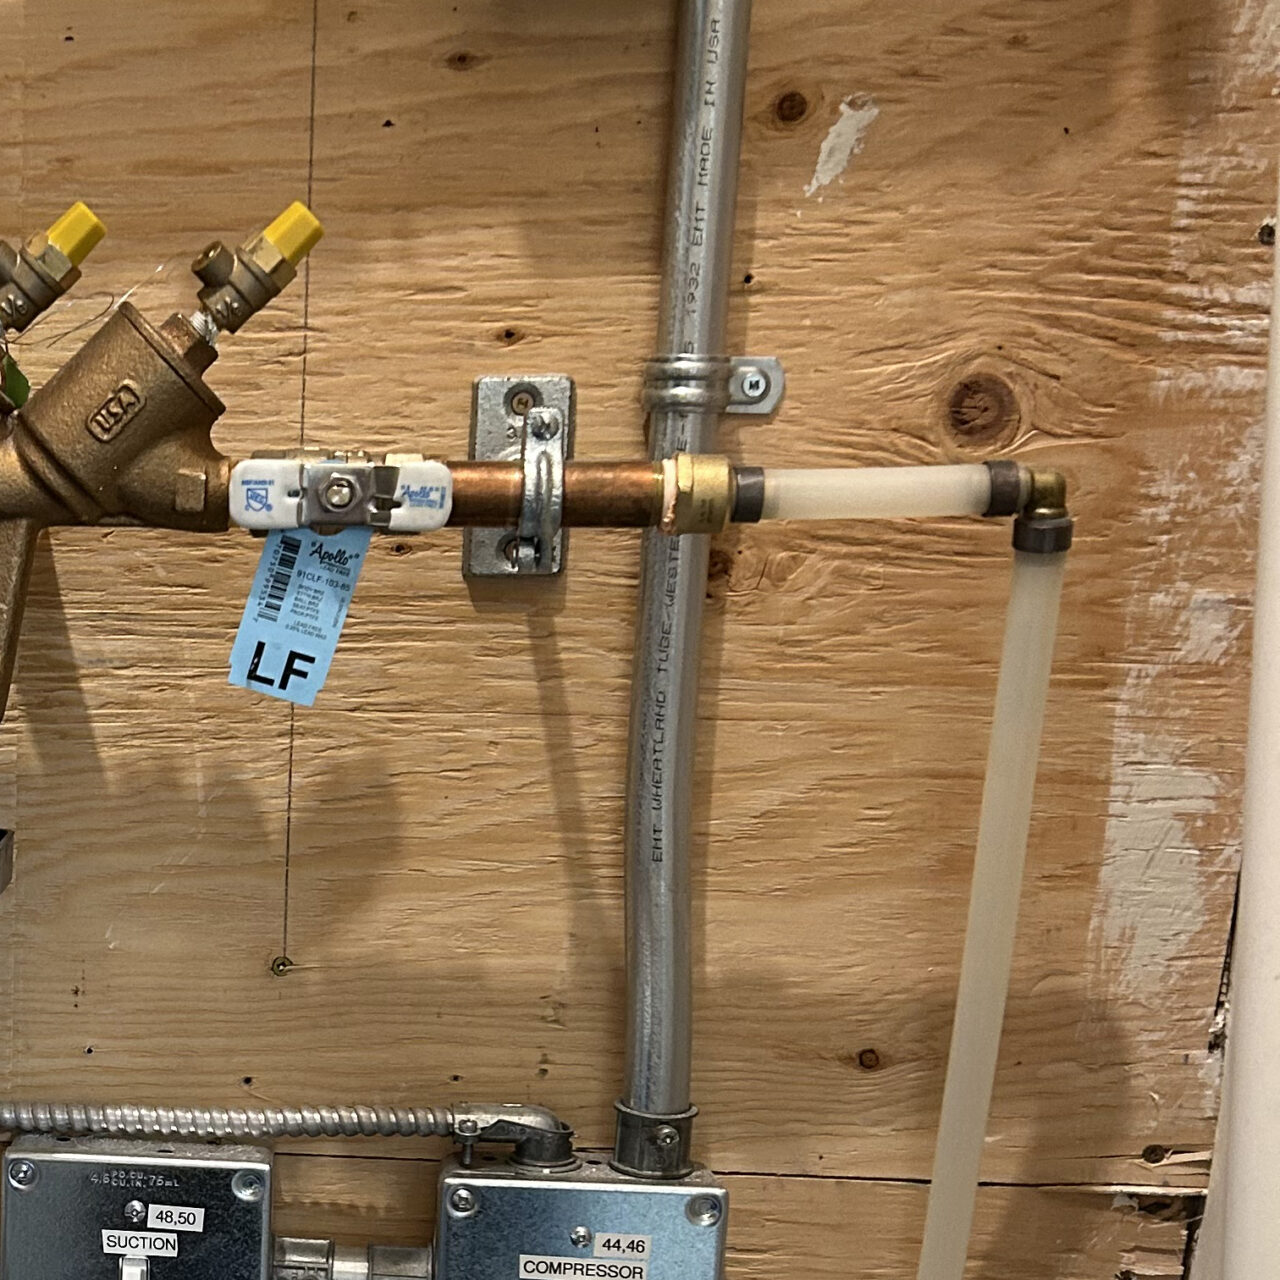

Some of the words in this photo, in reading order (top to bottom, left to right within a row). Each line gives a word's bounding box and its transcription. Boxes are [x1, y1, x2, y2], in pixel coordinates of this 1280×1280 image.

[709, 17, 721, 65] USA
[706, 80, 718, 107] IN
[698, 127, 712, 187] MADE
[94, 390, 137, 432] USA
[247, 640, 316, 690] LF
[653, 689, 666, 813] WHEATLAND
[155, 1210, 196, 1226] 48,50
[106, 1234, 177, 1252] SUCTION
[601, 1238, 645, 1255] 44,46
[523, 1260, 644, 1280] COMPRESSOR
